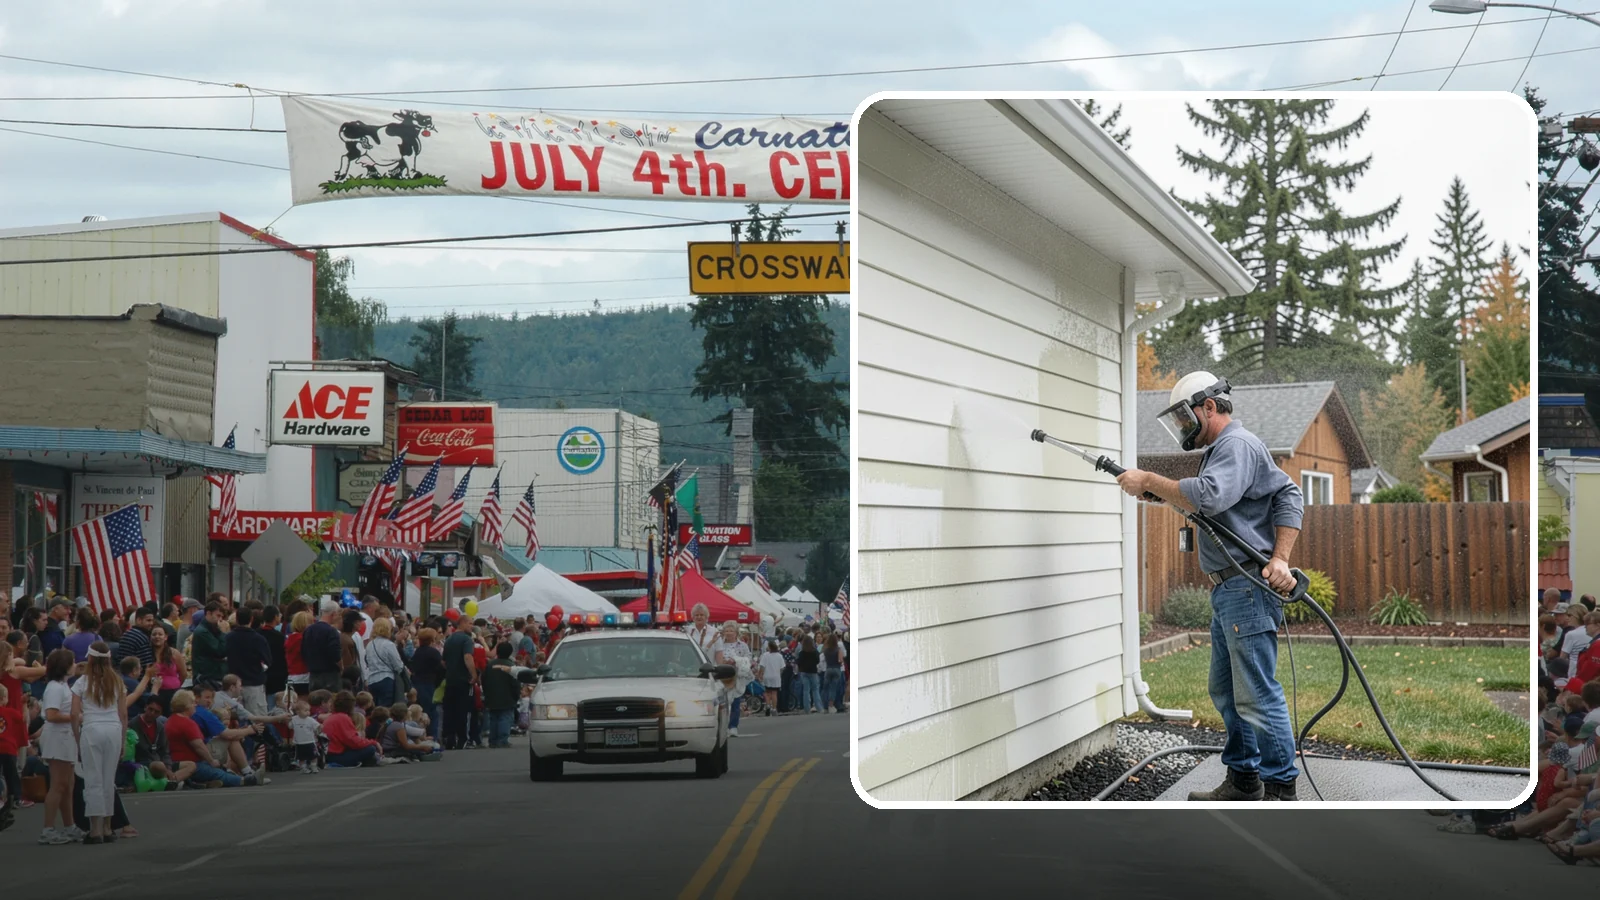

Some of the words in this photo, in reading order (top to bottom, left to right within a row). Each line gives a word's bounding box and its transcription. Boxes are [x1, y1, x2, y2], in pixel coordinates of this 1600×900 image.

[694, 121, 850, 150] Carnat
[481, 140, 605, 193] JULY
[632, 150, 746, 198] 4th.
[697, 254, 850, 280] CROSSWA
[282, 380, 373, 420] ACE
[405, 409, 453, 422] CEDAR
[461, 409, 485, 422] LOG
[283, 421, 371, 437] Hardware
[416, 428, 477, 447] Coca-Cola
[353, 467, 384, 480] Simpl
[83, 485, 93, 494] St.
[96, 485, 125, 495] Vincent
[126, 485, 136, 495] de
[137, 485, 155, 496] Paul
[688, 526, 741, 535] CRNATION
[699, 535, 730, 543] GLASS
